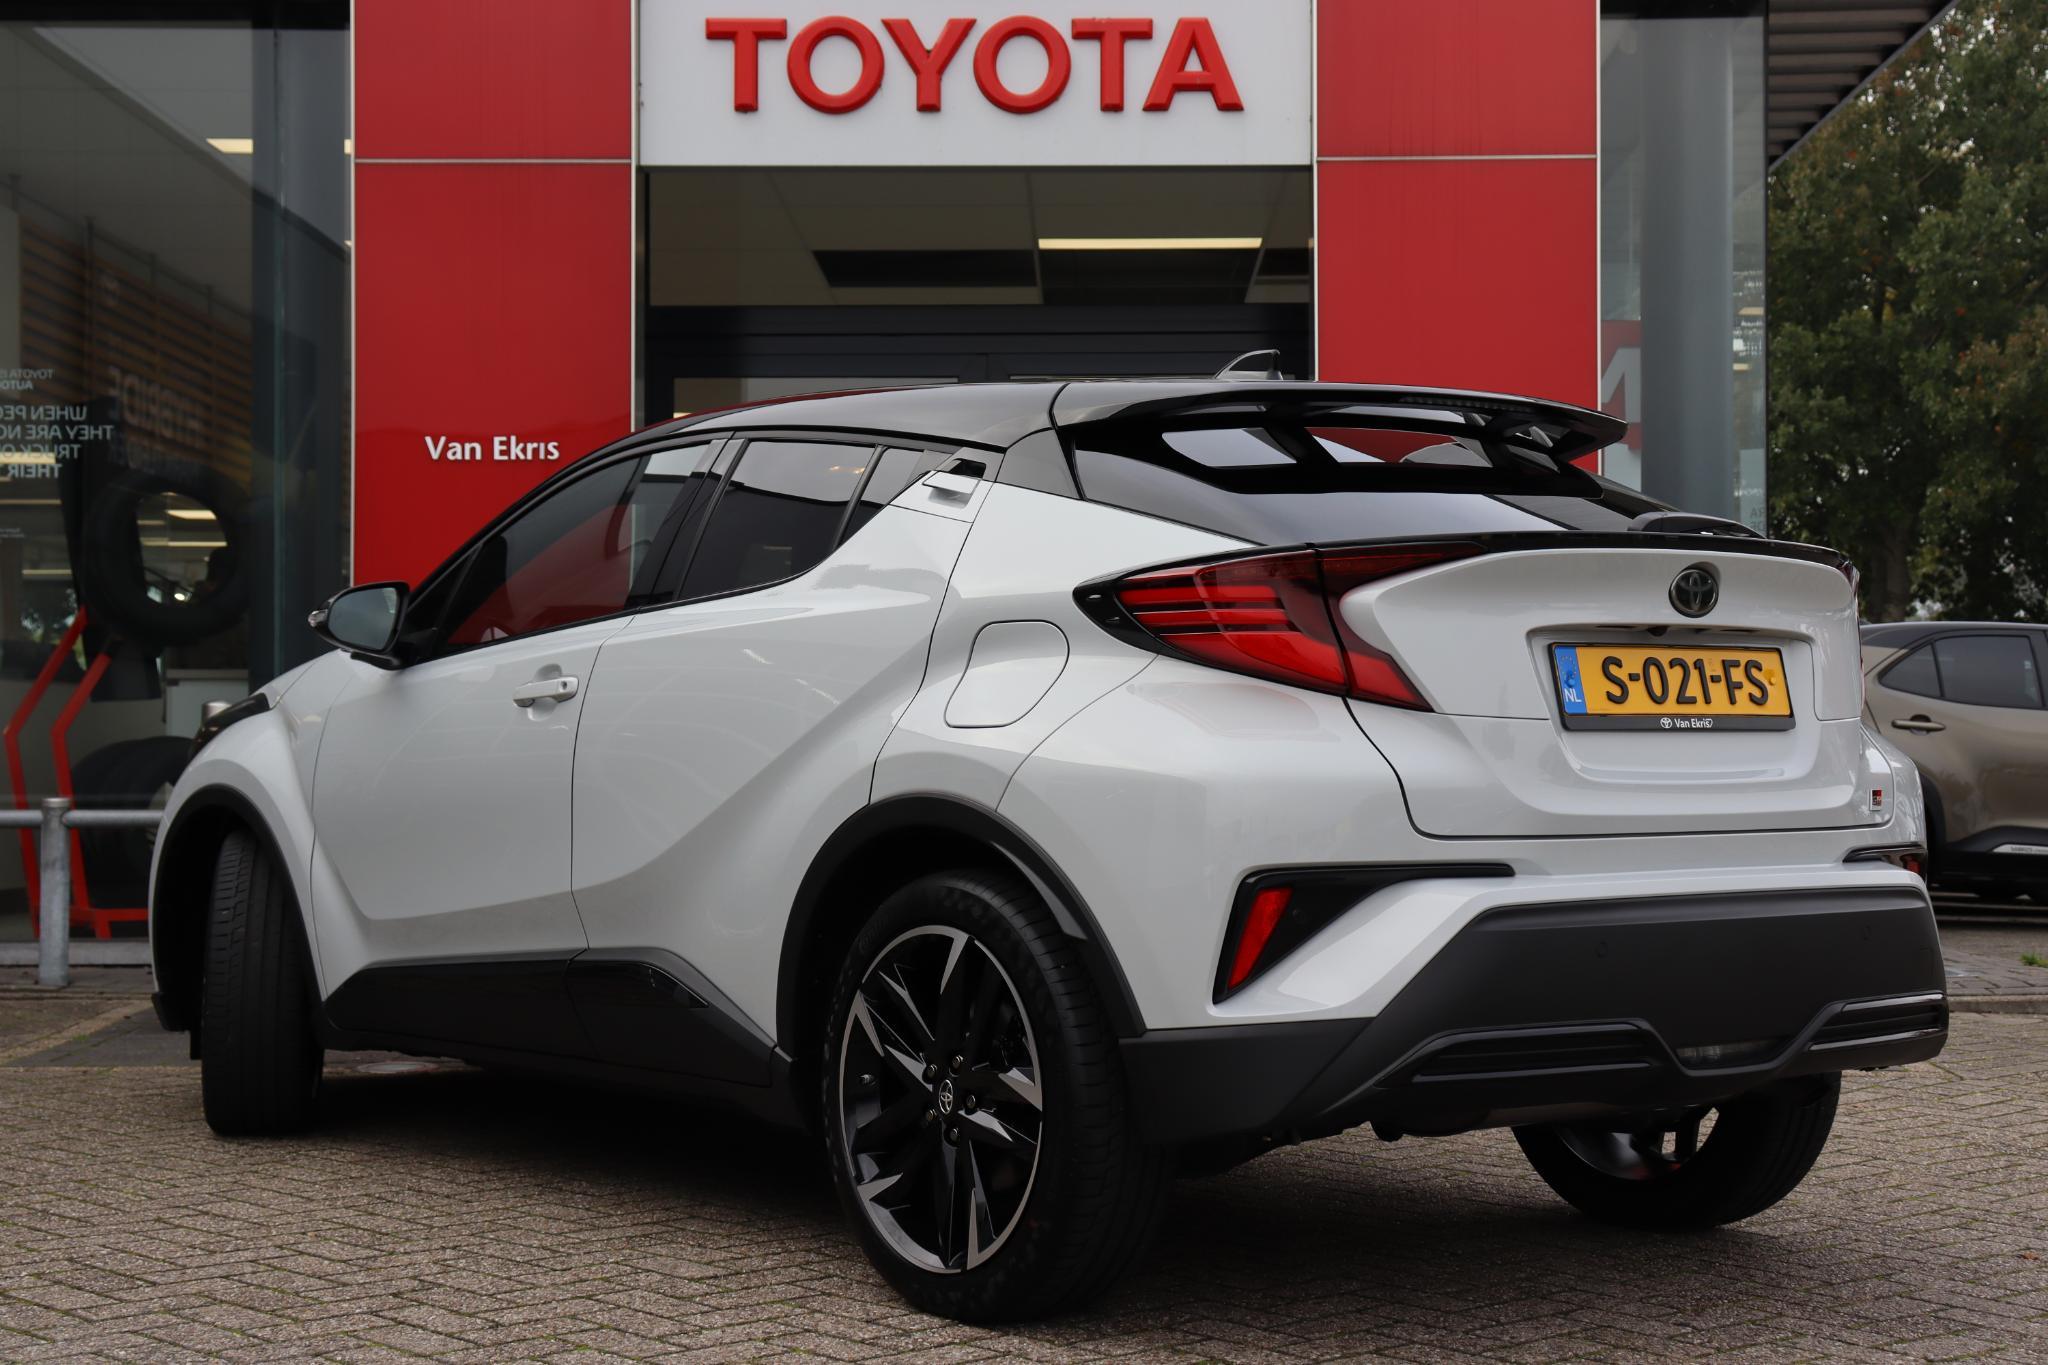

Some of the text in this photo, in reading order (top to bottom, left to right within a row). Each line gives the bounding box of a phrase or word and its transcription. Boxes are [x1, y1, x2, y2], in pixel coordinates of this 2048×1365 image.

[705, 15, 1244, 115] TOYOTA
[424, 435, 561, 460] Van Ekris
[1601, 655, 1769, 706] S-021-FS
[1564, 687, 1582, 704] NL
[1674, 718, 1690, 728] Van
